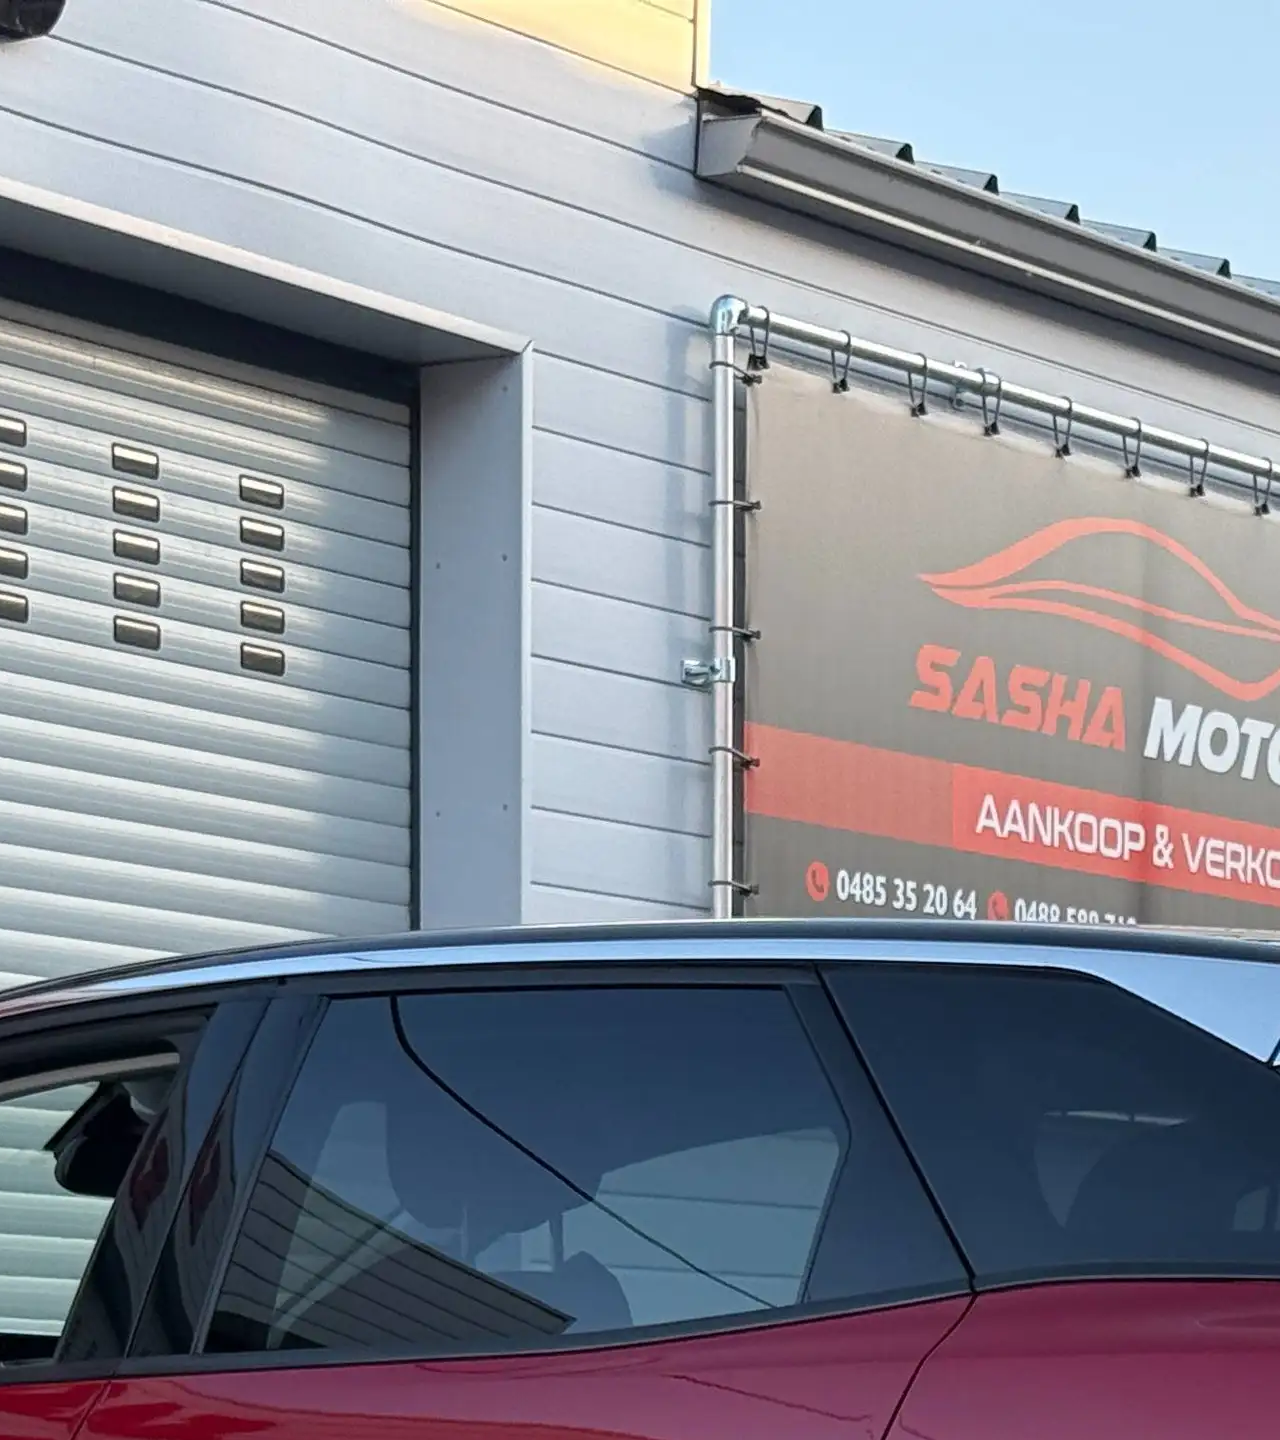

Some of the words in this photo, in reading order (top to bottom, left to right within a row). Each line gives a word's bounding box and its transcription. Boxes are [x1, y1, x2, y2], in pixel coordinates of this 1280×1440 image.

[910, 643, 1126, 752] SASHA
[975, 794, 1146, 862] AANKOOP
[1151, 823, 1174, 870] &
[836, 868, 887, 906] 0485
[892, 877, 917, 912] 35
[922, 883, 948, 916] 20
[952, 889, 978, 920] 64
